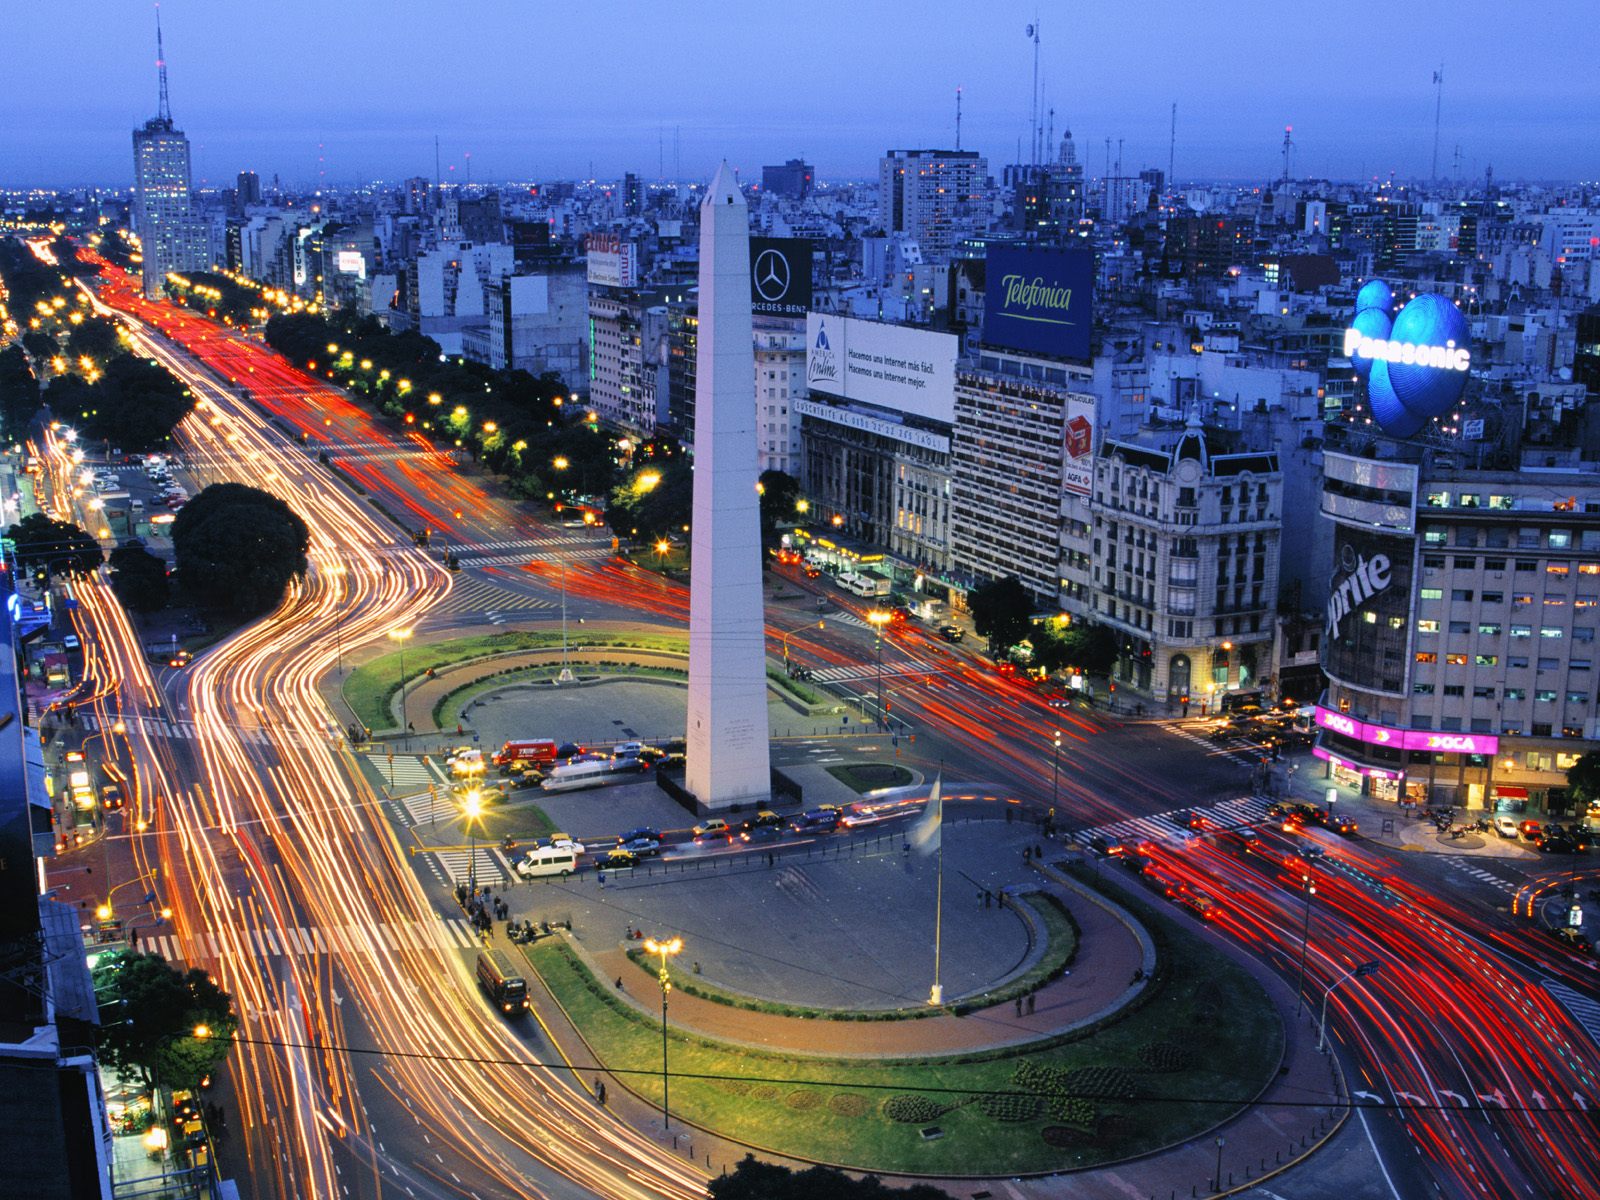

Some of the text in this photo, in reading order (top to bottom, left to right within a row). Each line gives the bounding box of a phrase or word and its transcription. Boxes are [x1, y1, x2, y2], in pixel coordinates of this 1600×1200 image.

[621, 244, 629, 286] aiwa
[811, 349, 835, 359] AMERICA
[848, 347, 872, 362] Hacemos
[873, 355, 883, 364] una
[884, 355, 907, 369] Internet
[1344, 328, 1470, 371] Panasonic
[848, 362, 926, 390] Hacemos una Internet mejor.
[1067, 472, 1082, 483] AGFA
